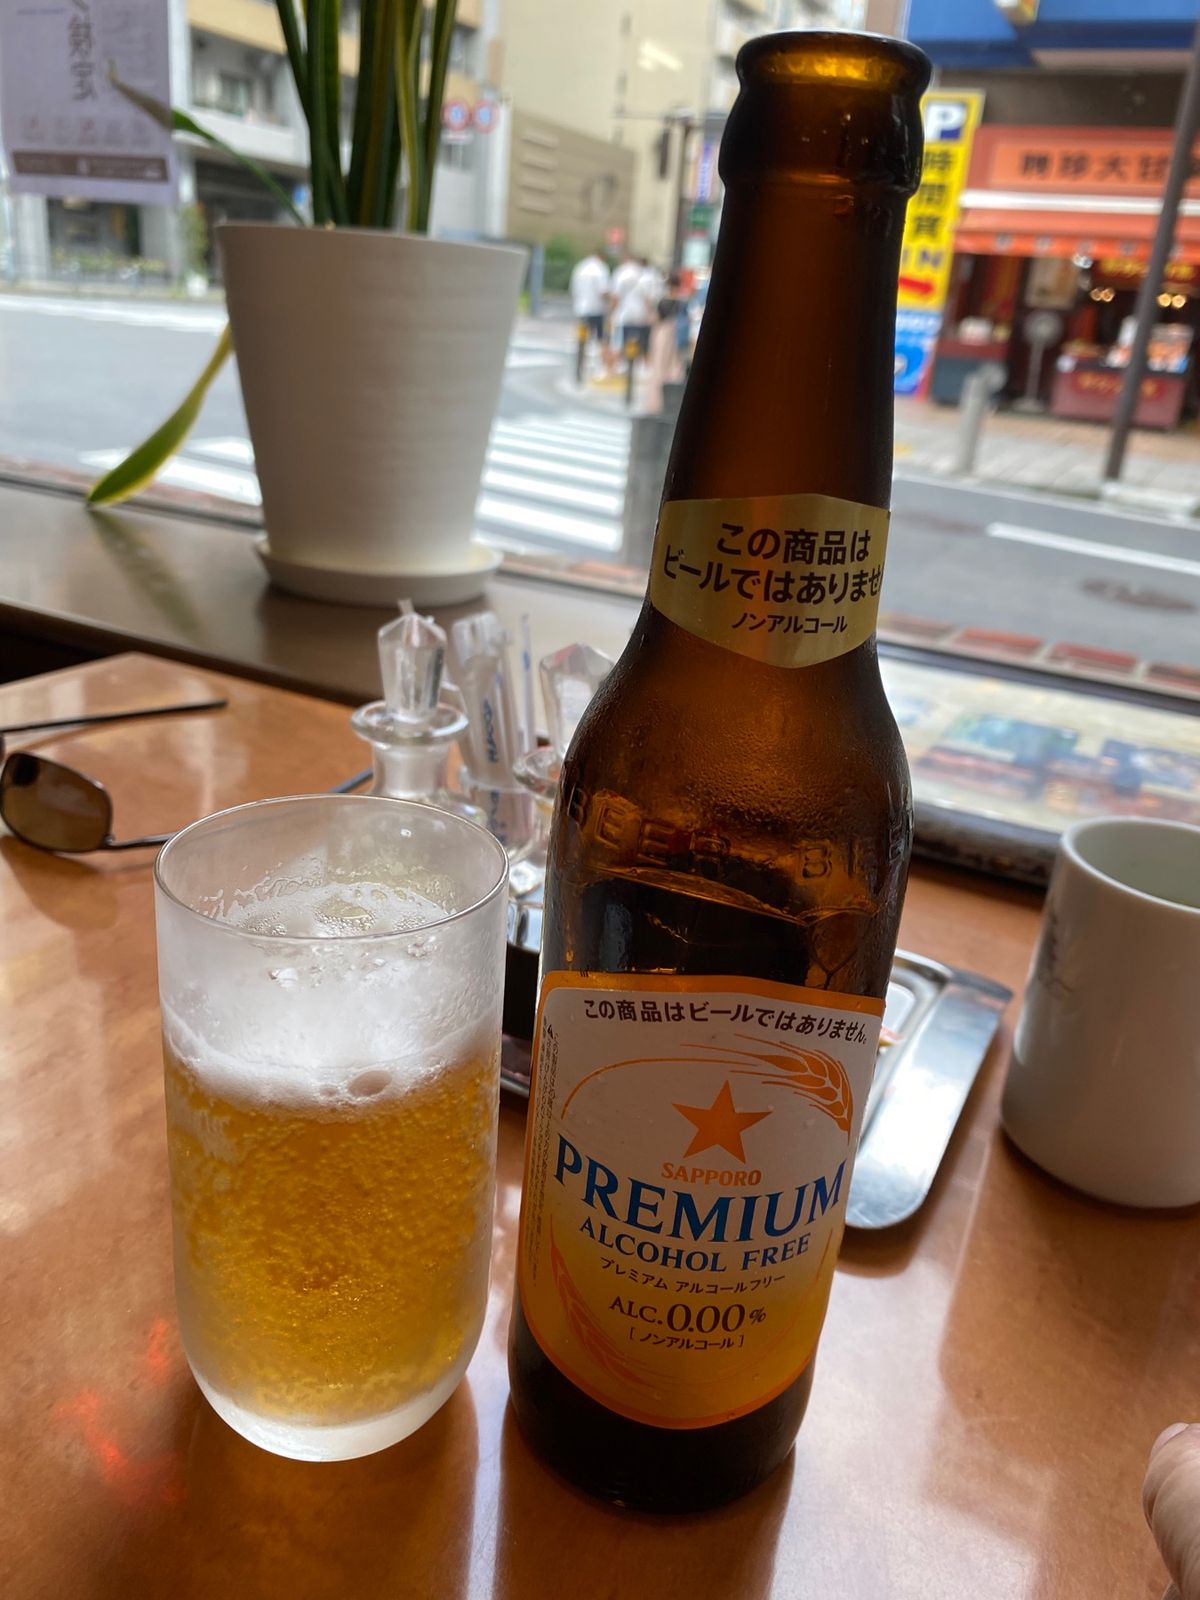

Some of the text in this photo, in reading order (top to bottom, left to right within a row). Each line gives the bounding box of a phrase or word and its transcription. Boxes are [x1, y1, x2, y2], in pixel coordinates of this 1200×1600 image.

[925, 102, 965, 140] P
[717, 523, 871, 566] この商品は
[732, 612, 848, 634] ノンアルコール
[584, 999, 868, 1045] この商品はビールではありません。
[553, 1132, 847, 1243] PREMIUM
[661, 1162, 762, 1187] SAPPORO
[579, 1216, 812, 1273] ALCOHOL FREE
[600, 1256, 786, 1295] プレミアム アルコールフリー
